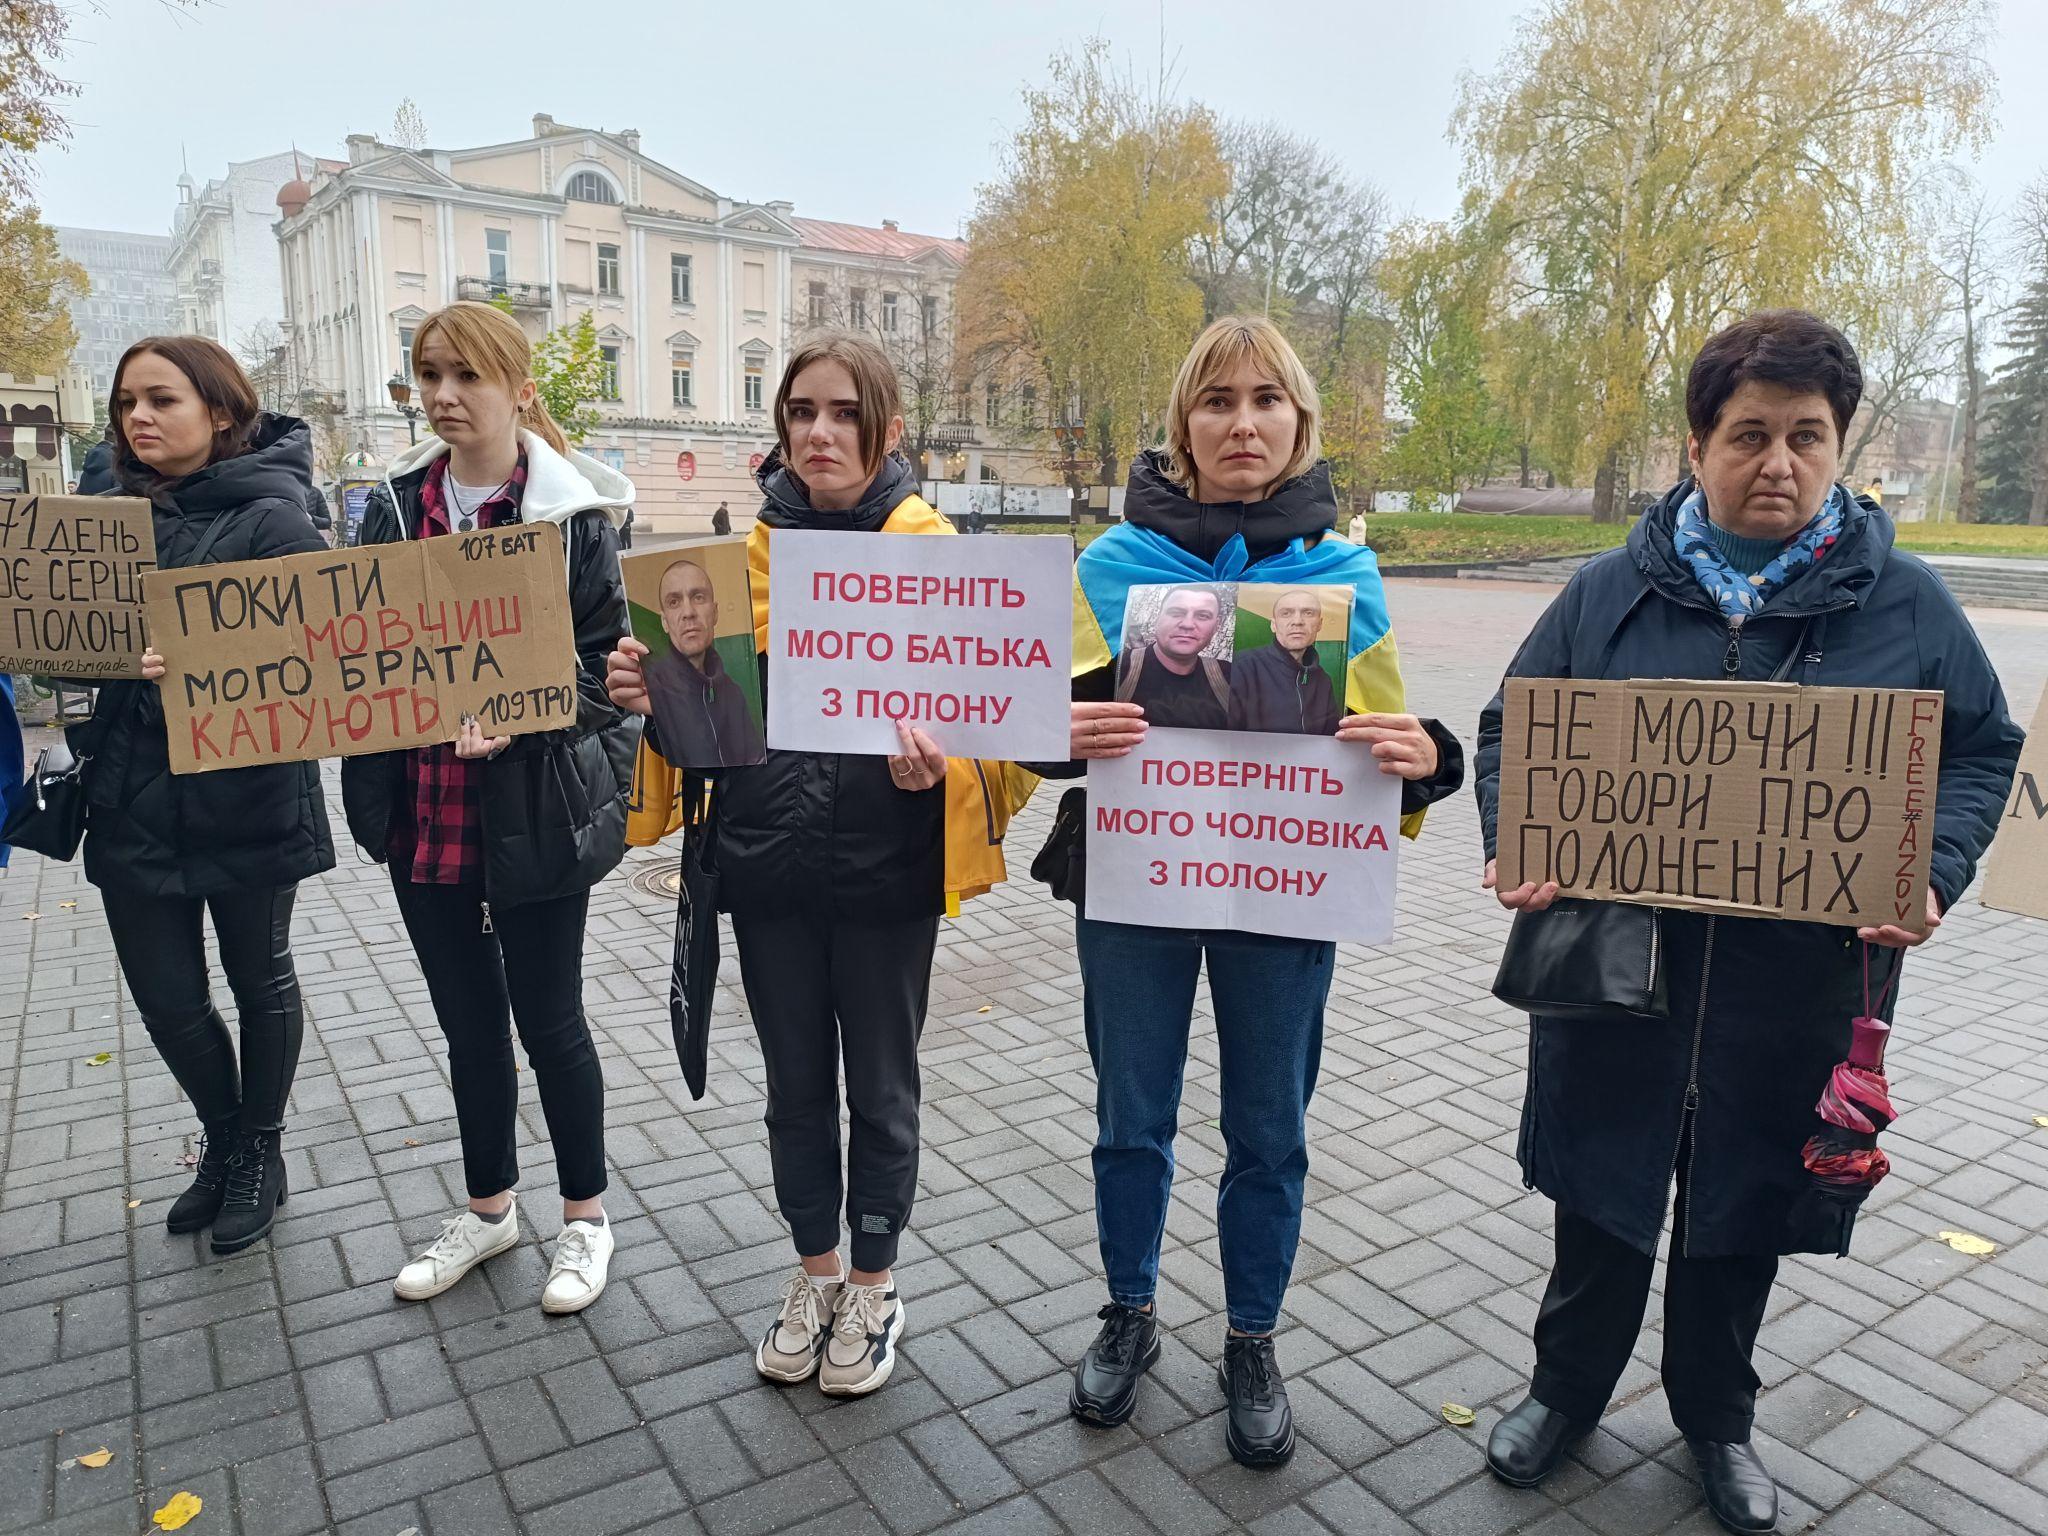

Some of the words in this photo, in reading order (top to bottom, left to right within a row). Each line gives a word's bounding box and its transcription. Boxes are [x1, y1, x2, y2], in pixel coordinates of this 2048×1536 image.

[41, 518, 139, 556] ДЕНЬ
[458, 533, 497, 561] 107
[502, 531, 541, 558] БАТ
[175, 573, 304, 637] ПОКИ
[317, 558, 385, 618] ТИ
[812, 571, 1026, 608] ПОВЕРНІТЬ
[302, 595, 522, 662] МОВЧИШ
[787, 629, 894, 662] МОГО
[907, 634, 1052, 668] БАТЬКА
[184, 655, 313, 708] МОГО
[339, 640, 504, 692] БРАТА
[190, 688, 440, 760] КАТУЮТЬ
[821, 687, 843, 717] З
[856, 689, 1013, 725] ПОЛОНУ
[1525, 688, 1597, 761] НЕ
[1630, 695, 1820, 772] МОВЧИ
[1141, 759, 1344, 796] ПОВЕРНІТЬ
[1525, 767, 1713, 830] ГОВОРИ
[1757, 778, 1871, 843] ПРО
[1096, 806, 1194, 838] МОГО
[1206, 812, 1389, 851] ЧОЛОВІКА
[1148, 860, 1168, 886] З
[1181, 862, 1328, 897] ПОЛОНУ
[1519, 824, 1863, 914] ПОЛОНЕНИХ
